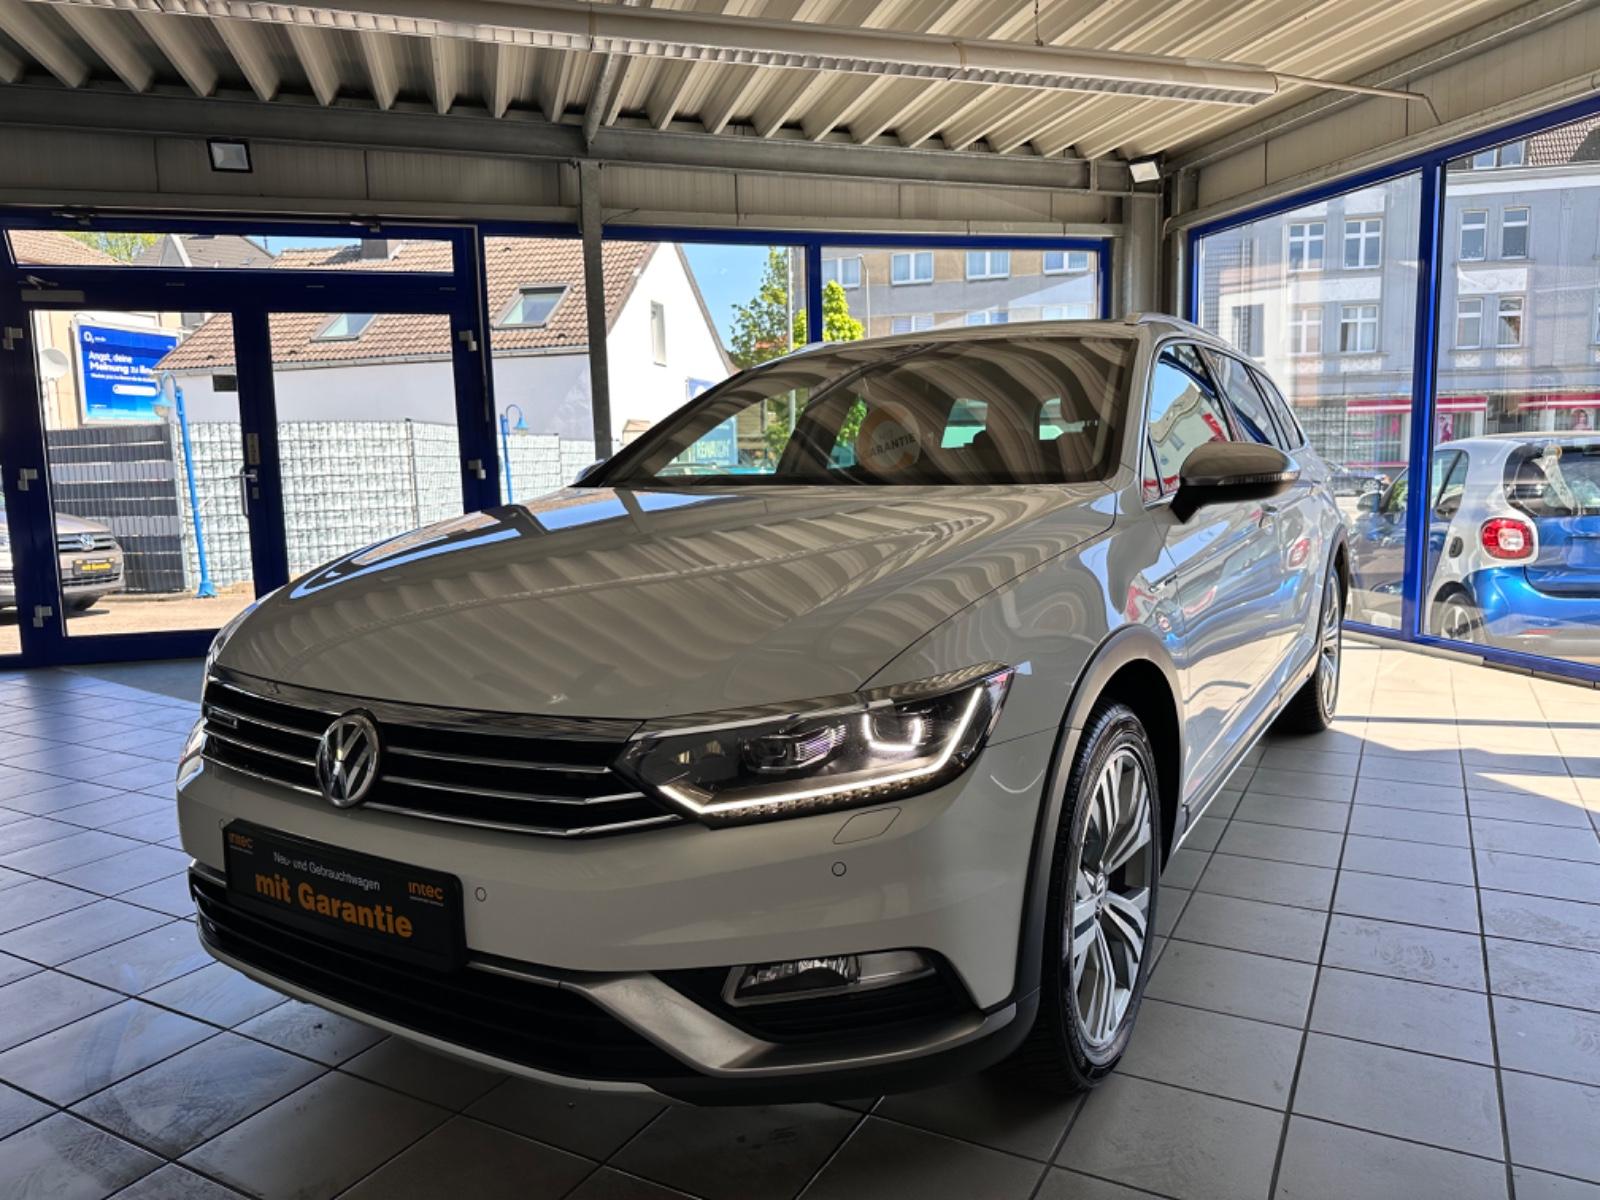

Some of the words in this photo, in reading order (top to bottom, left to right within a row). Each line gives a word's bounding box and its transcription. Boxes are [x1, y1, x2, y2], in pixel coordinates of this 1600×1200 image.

[90, 361, 129, 374] Meinung
[293, 859, 307, 872] und
[309, 861, 380, 891] Gebrauchtwagen
[408, 881, 444, 901] intec
[255, 873, 291, 904] mit
[298, 882, 413, 937] Garantie
